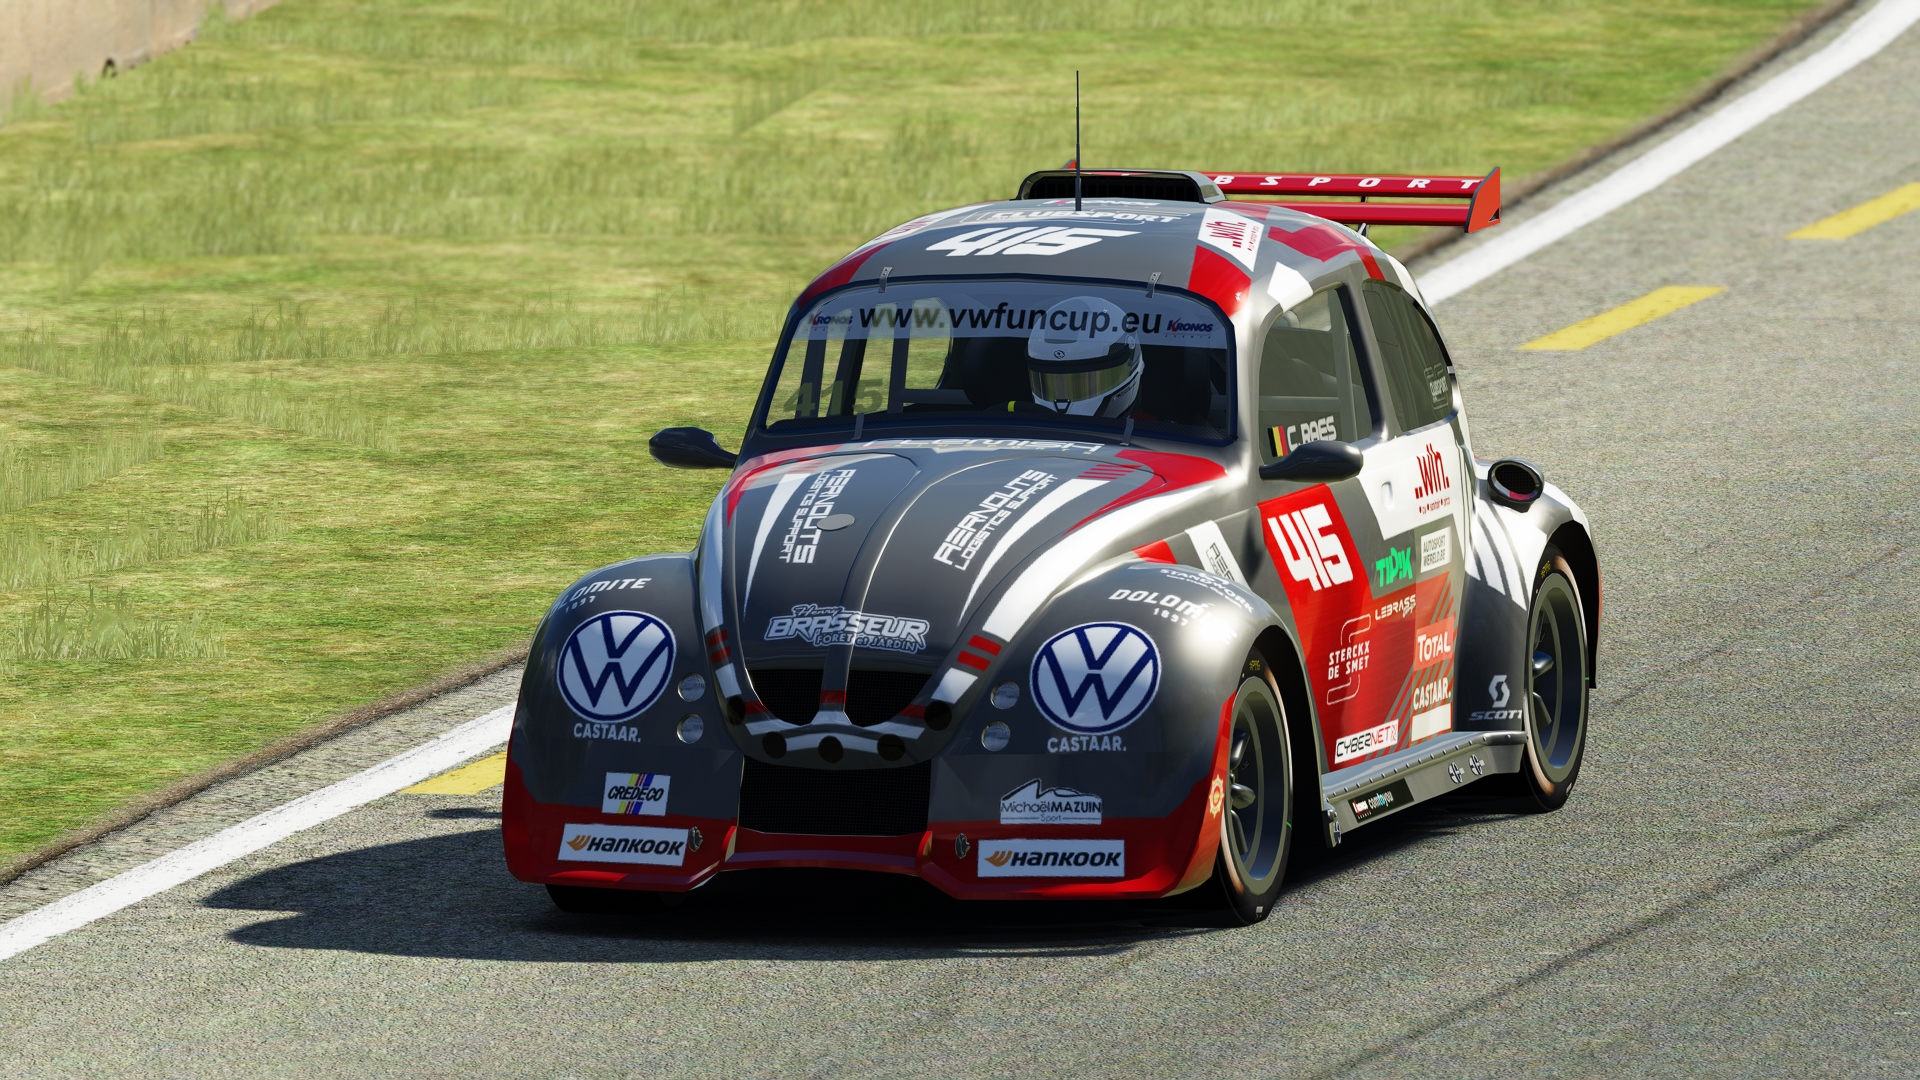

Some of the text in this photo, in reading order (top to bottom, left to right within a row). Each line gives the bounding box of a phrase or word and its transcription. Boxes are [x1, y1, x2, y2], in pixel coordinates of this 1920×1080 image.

[926, 226, 1142, 257] 415
[859, 302, 1162, 339] www.vwfuncup.eu
[1166, 317, 1214, 333] KRONOS
[932, 468, 1049, 567] AERNOUTS
[954, 473, 1059, 572] LOGISTICS SUPPORT
[778, 507, 810, 564] SUPPORT
[1267, 503, 1354, 592] 415
[794, 604, 845, 617] Henry
[1153, 607, 1189, 627] 1897
[1374, 593, 1416, 621] LEBRASS
[766, 612, 927, 645] BRASSEUR
[871, 637, 918, 652] JARDIN
[1328, 640, 1371, 666] STERCKX
[1417, 631, 1451, 663] TOTAL
[1327, 654, 1370, 681] DE SMET
[1412, 676, 1452, 711] CASTAAR.
[573, 723, 642, 743] CASTAAR.
[1047, 736, 1127, 753] CASTAAR.
[607, 785, 664, 802] CREDECO
[1050, 801, 1102, 813] MAZUIN
[1040, 813, 1062, 823] Sport
